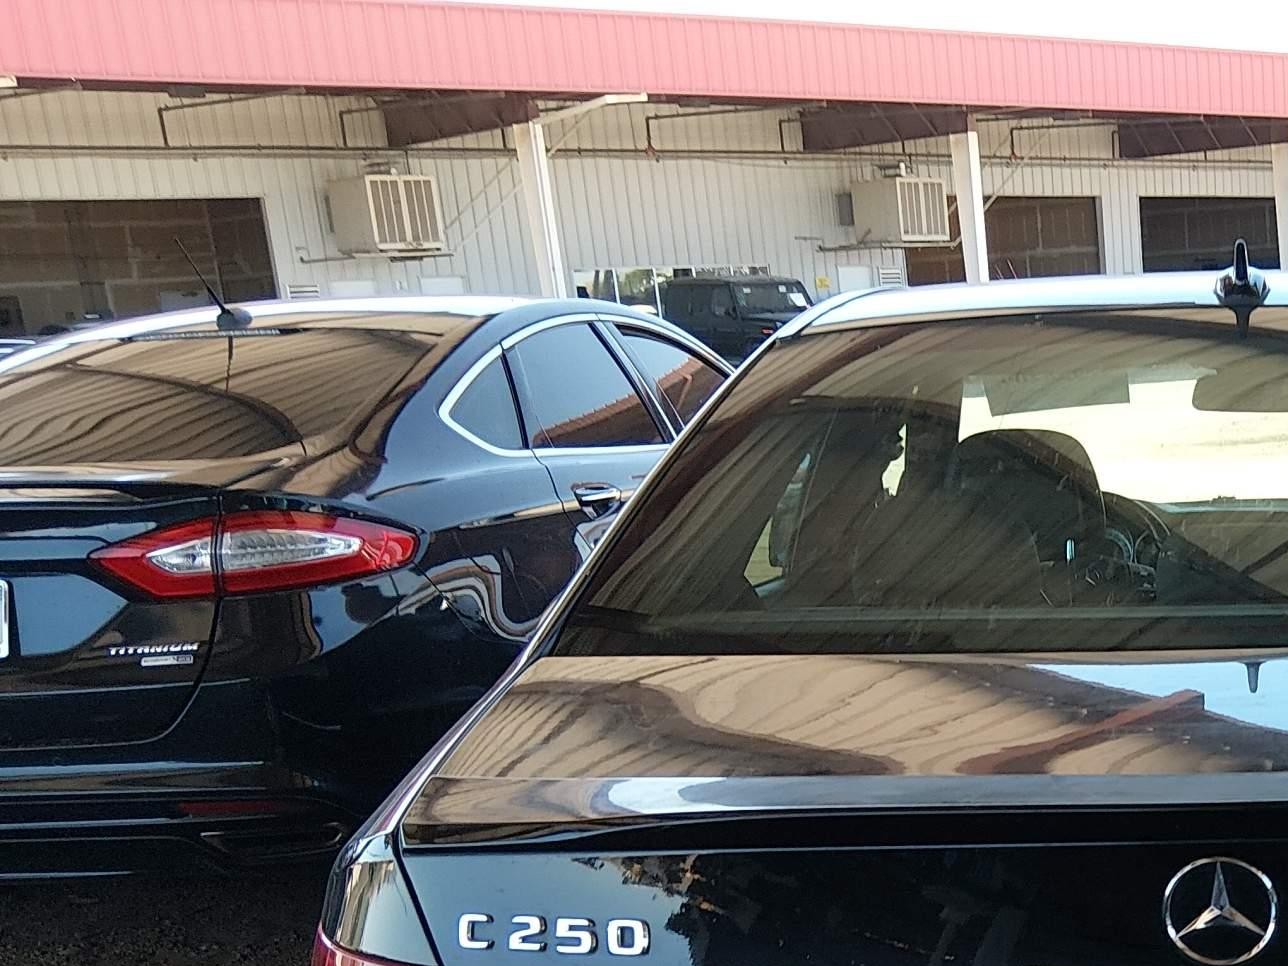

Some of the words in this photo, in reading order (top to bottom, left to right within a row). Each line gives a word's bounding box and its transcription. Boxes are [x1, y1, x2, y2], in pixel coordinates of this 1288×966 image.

[109, 642, 200, 655] TITANIUM
[458, 913, 493, 949] C
[508, 915, 650, 956] 250
